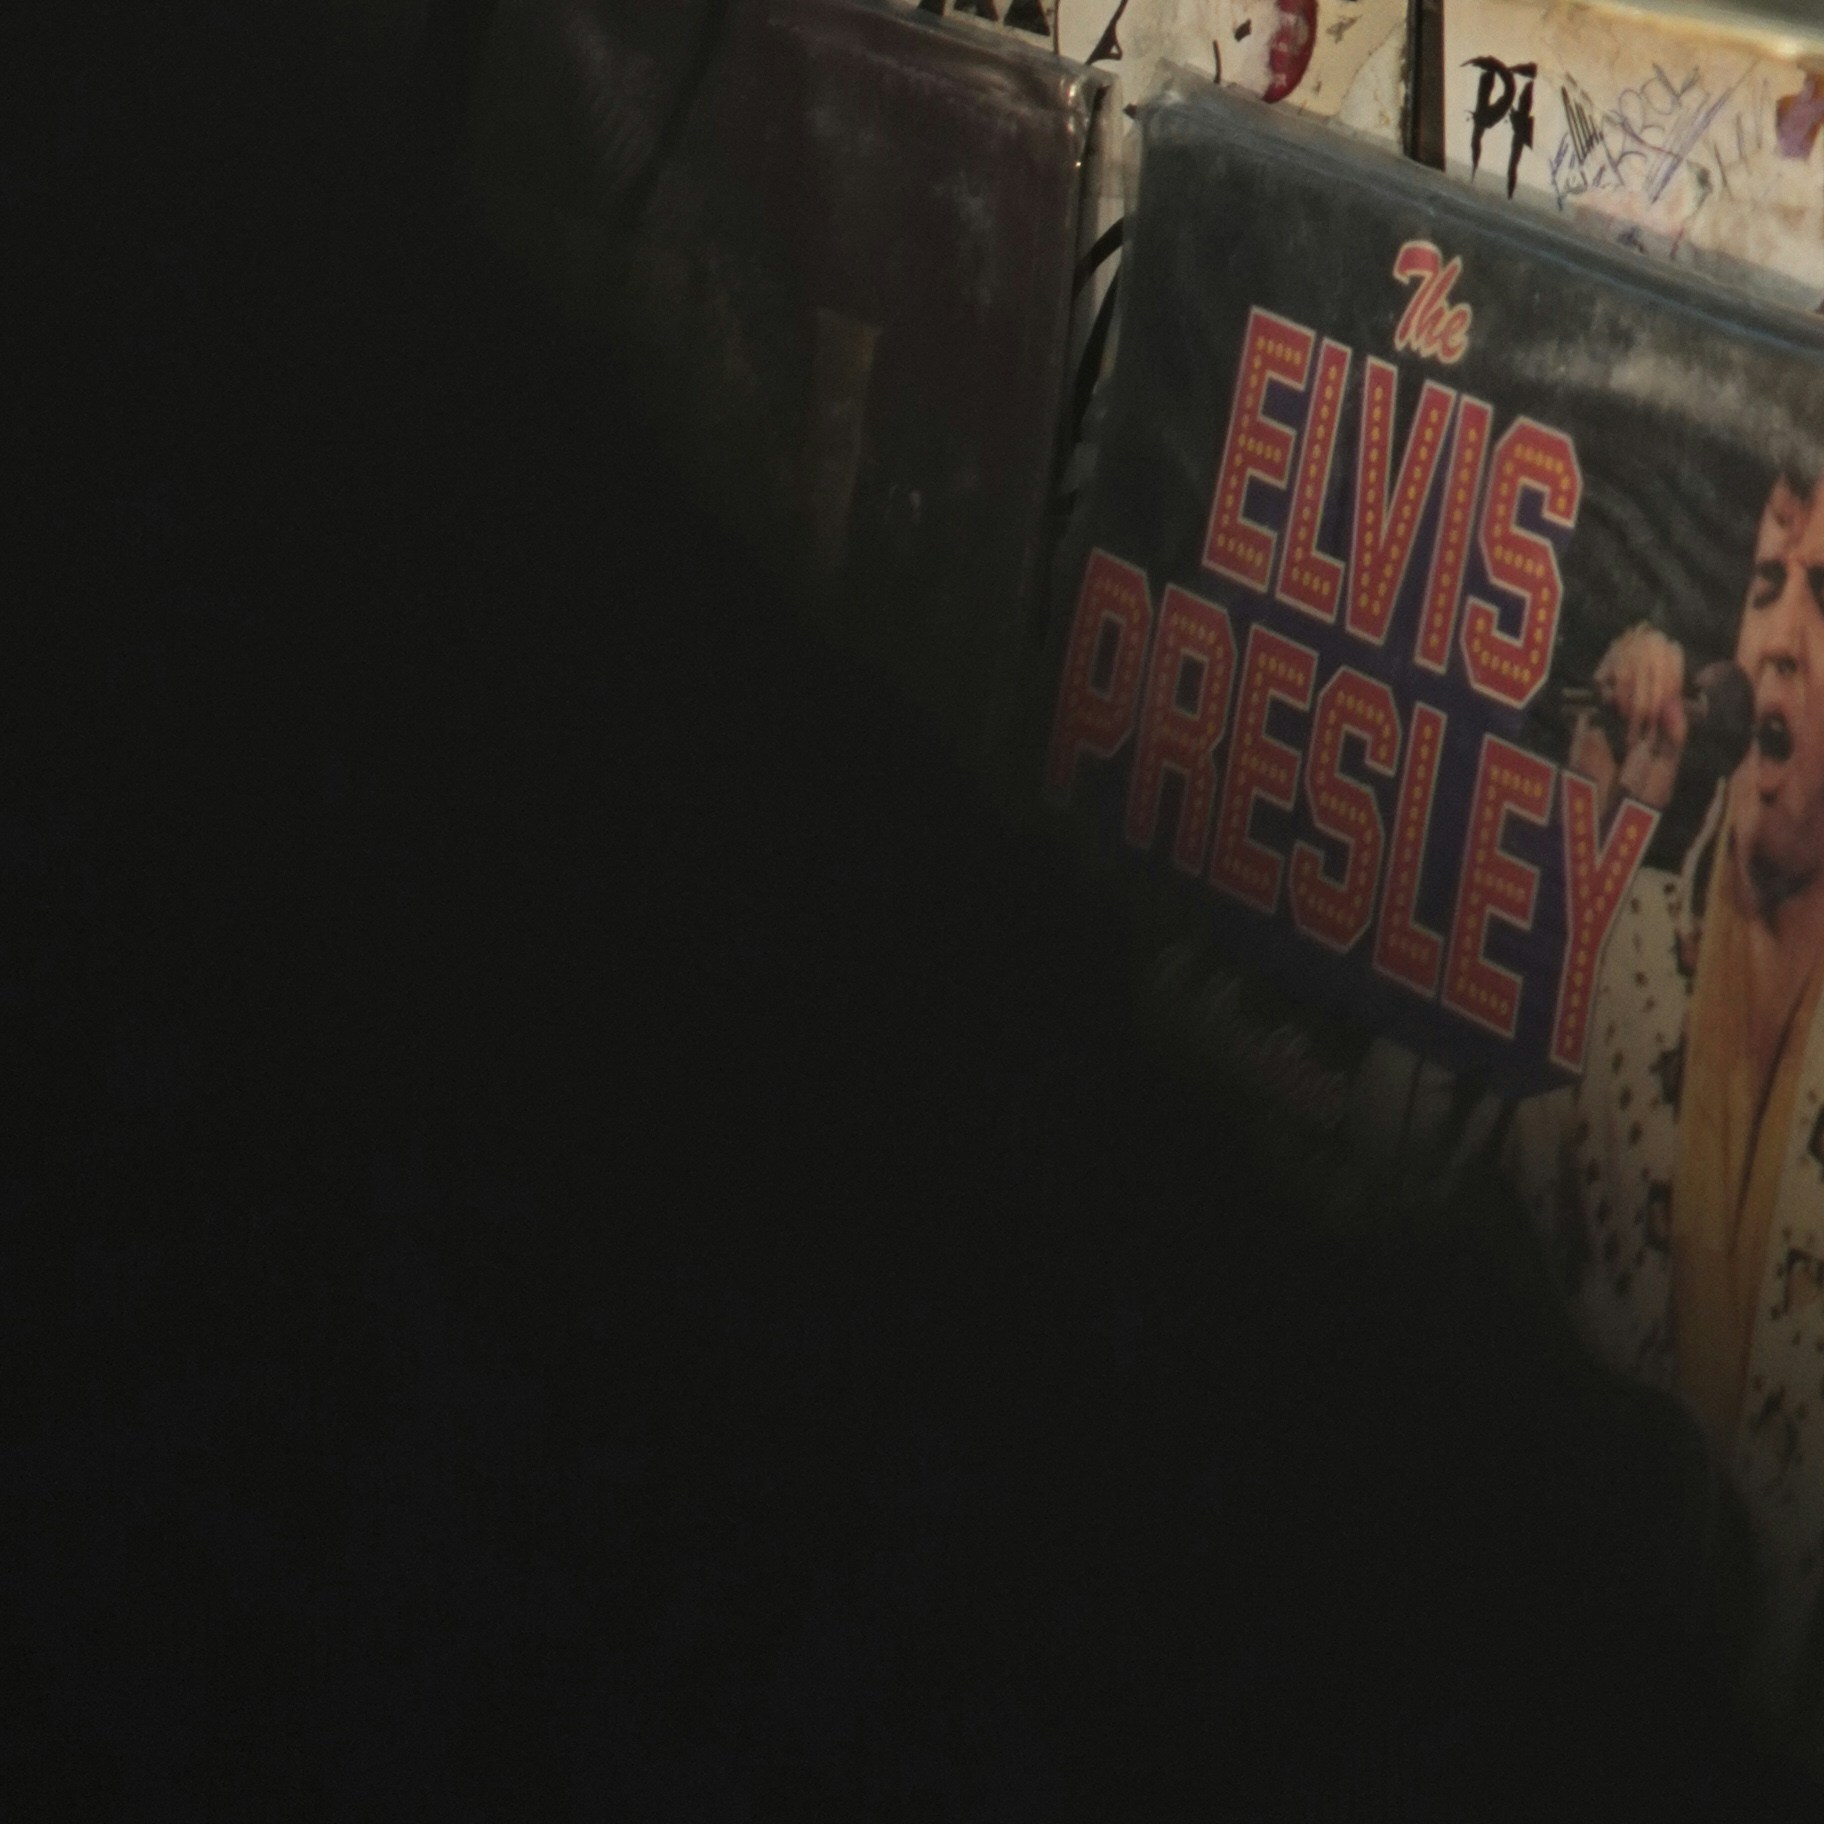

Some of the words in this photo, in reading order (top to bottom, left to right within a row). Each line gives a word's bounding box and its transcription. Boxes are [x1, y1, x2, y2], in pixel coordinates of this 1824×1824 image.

[1391, 240, 1471, 365] The
[1203, 305, 1583, 710] ELVIS
[1042, 547, 1661, 1074] PRESLEY
